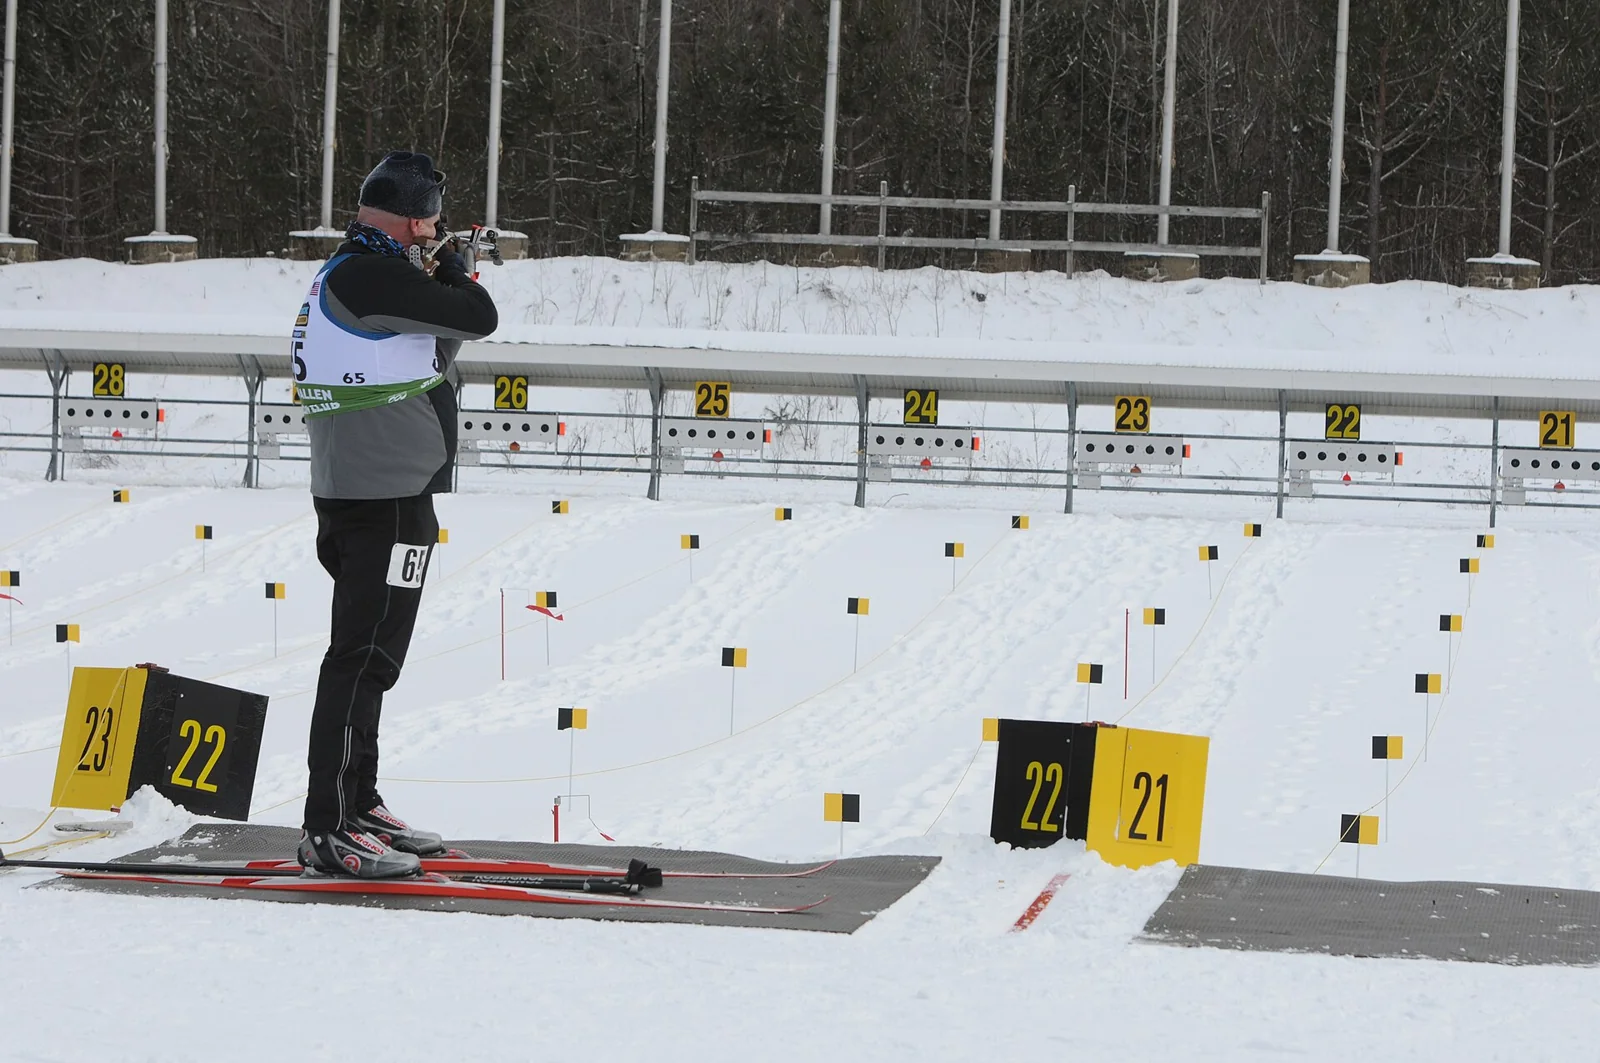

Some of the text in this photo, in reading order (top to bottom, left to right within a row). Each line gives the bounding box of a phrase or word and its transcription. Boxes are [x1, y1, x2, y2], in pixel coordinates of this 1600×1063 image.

[291, 341, 307, 381] 5
[94, 364, 124, 395] 28
[342, 373, 366, 384] 65
[495, 376, 527, 409] 26
[698, 384, 728, 415] 25
[905, 390, 937, 423] 24
[1116, 398, 1149, 430] 23
[1327, 405, 1360, 438] 22
[1543, 413, 1570, 445] 21
[77, 706, 114, 772] 23
[171, 719, 226, 793] 22
[1020, 761, 1063, 832] 22
[1128, 772, 1169, 842] 21
